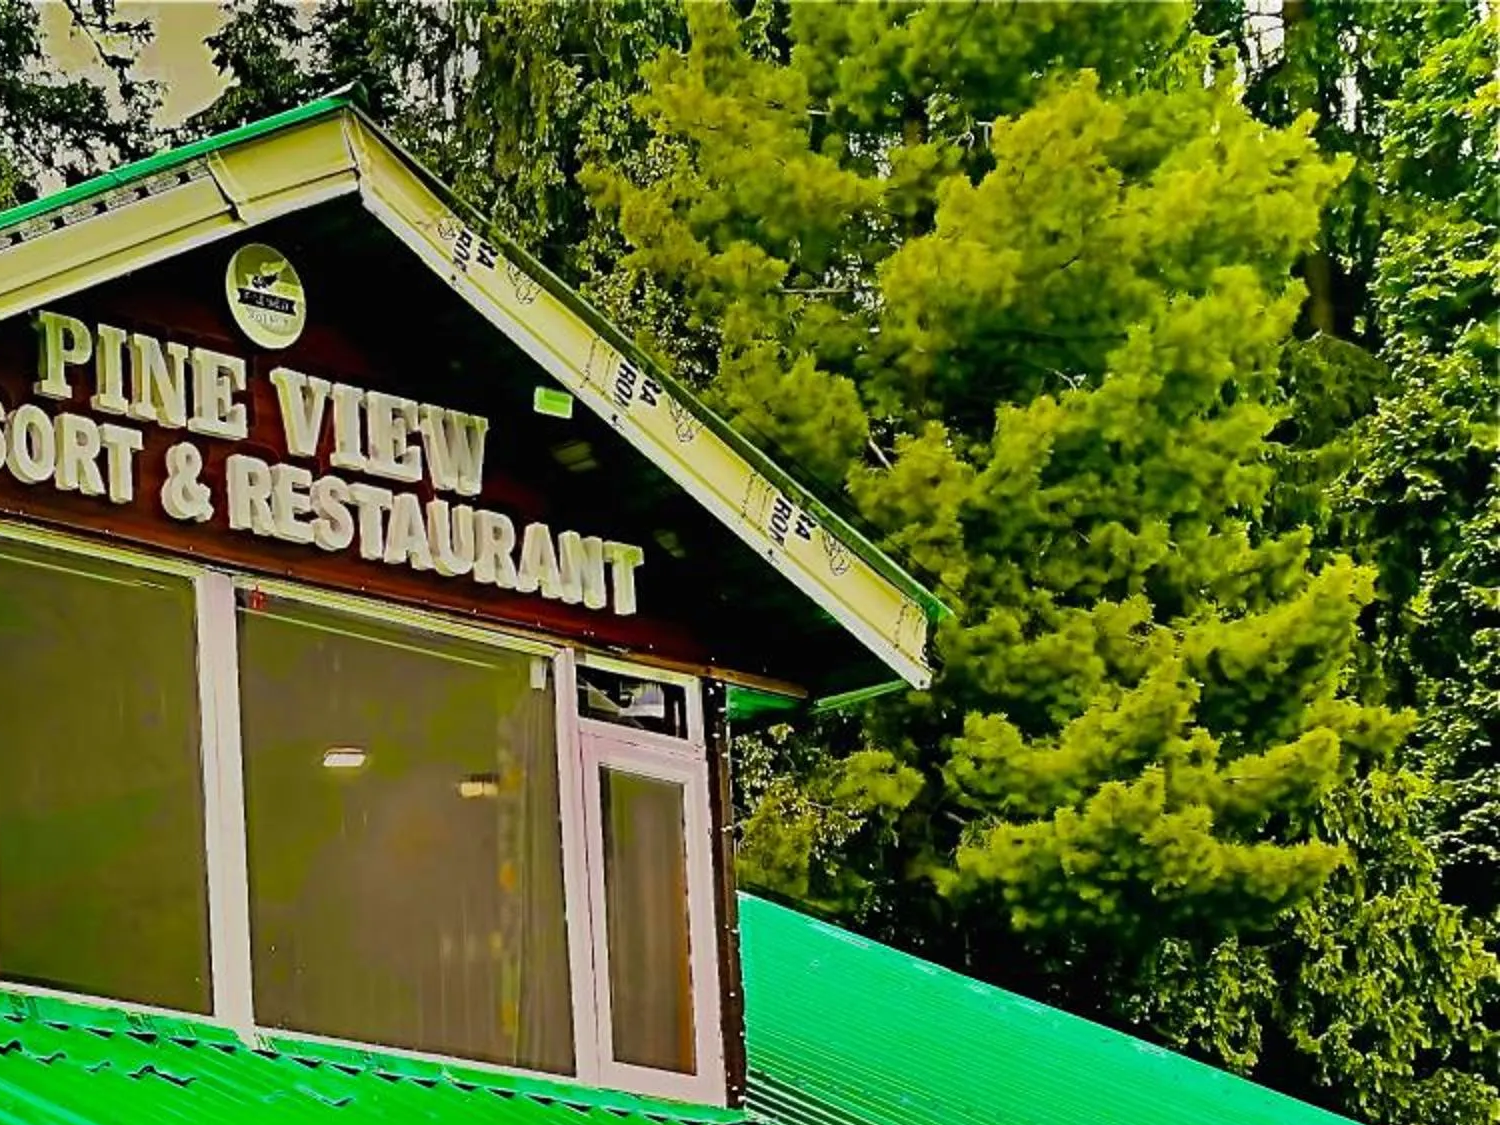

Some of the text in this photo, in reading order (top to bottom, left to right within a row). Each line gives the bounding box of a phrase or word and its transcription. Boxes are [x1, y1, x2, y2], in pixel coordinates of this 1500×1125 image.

[34, 310, 489, 496] PINE VIEW
[161, 441, 214, 523] &
[227, 452, 643, 616] RESTAURANT
